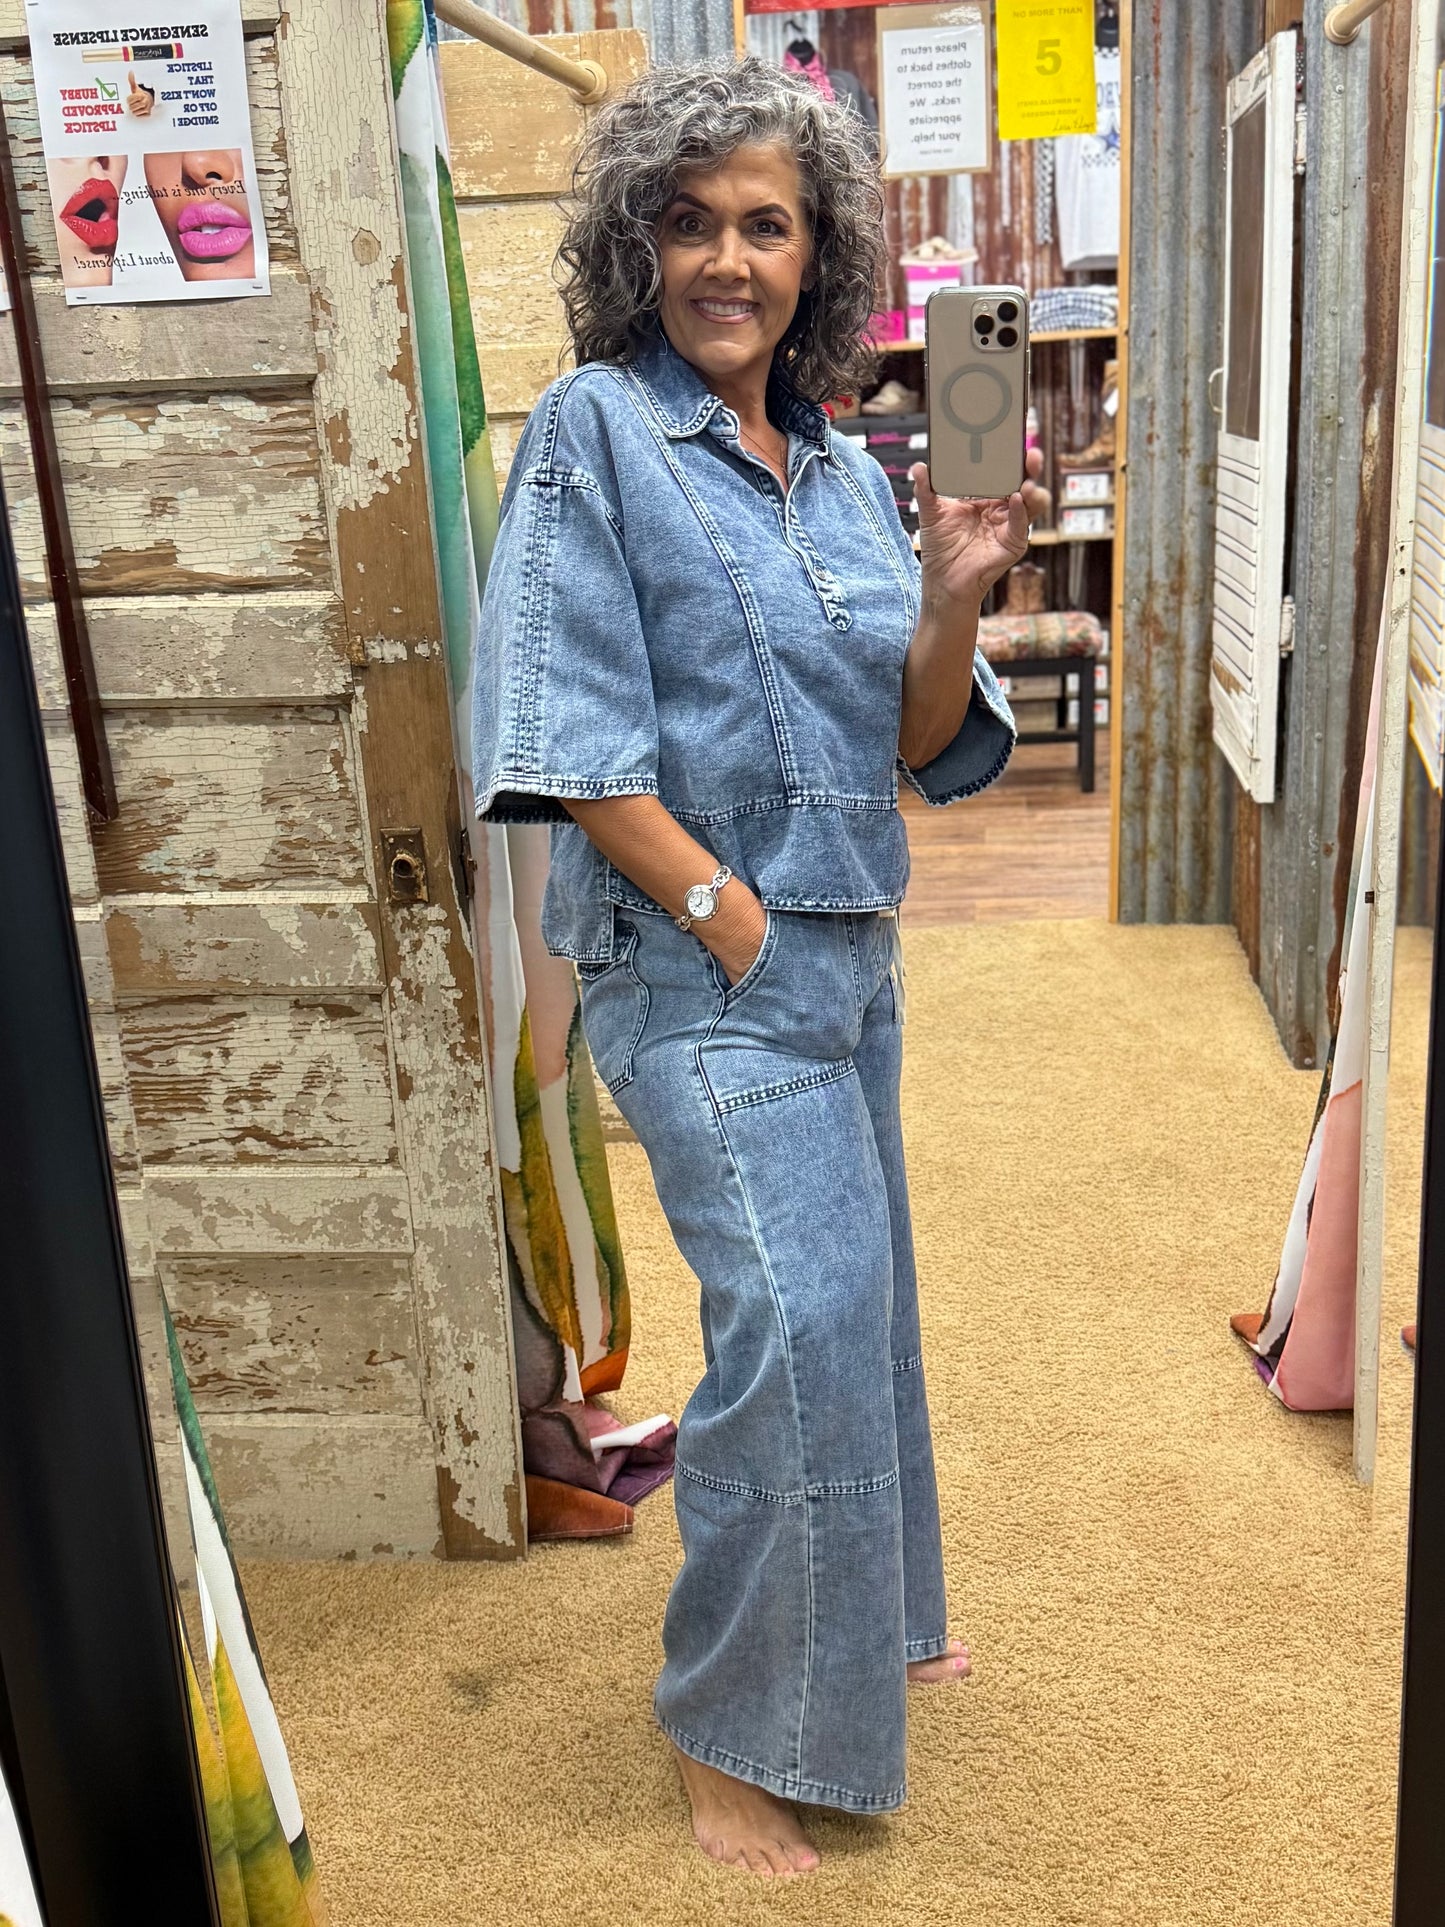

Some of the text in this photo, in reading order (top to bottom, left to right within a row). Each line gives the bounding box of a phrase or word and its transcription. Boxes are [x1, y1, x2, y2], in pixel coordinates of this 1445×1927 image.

[1012, 7, 1083, 18] NO MORE THAN
[1035, 38, 1062, 76] 5
